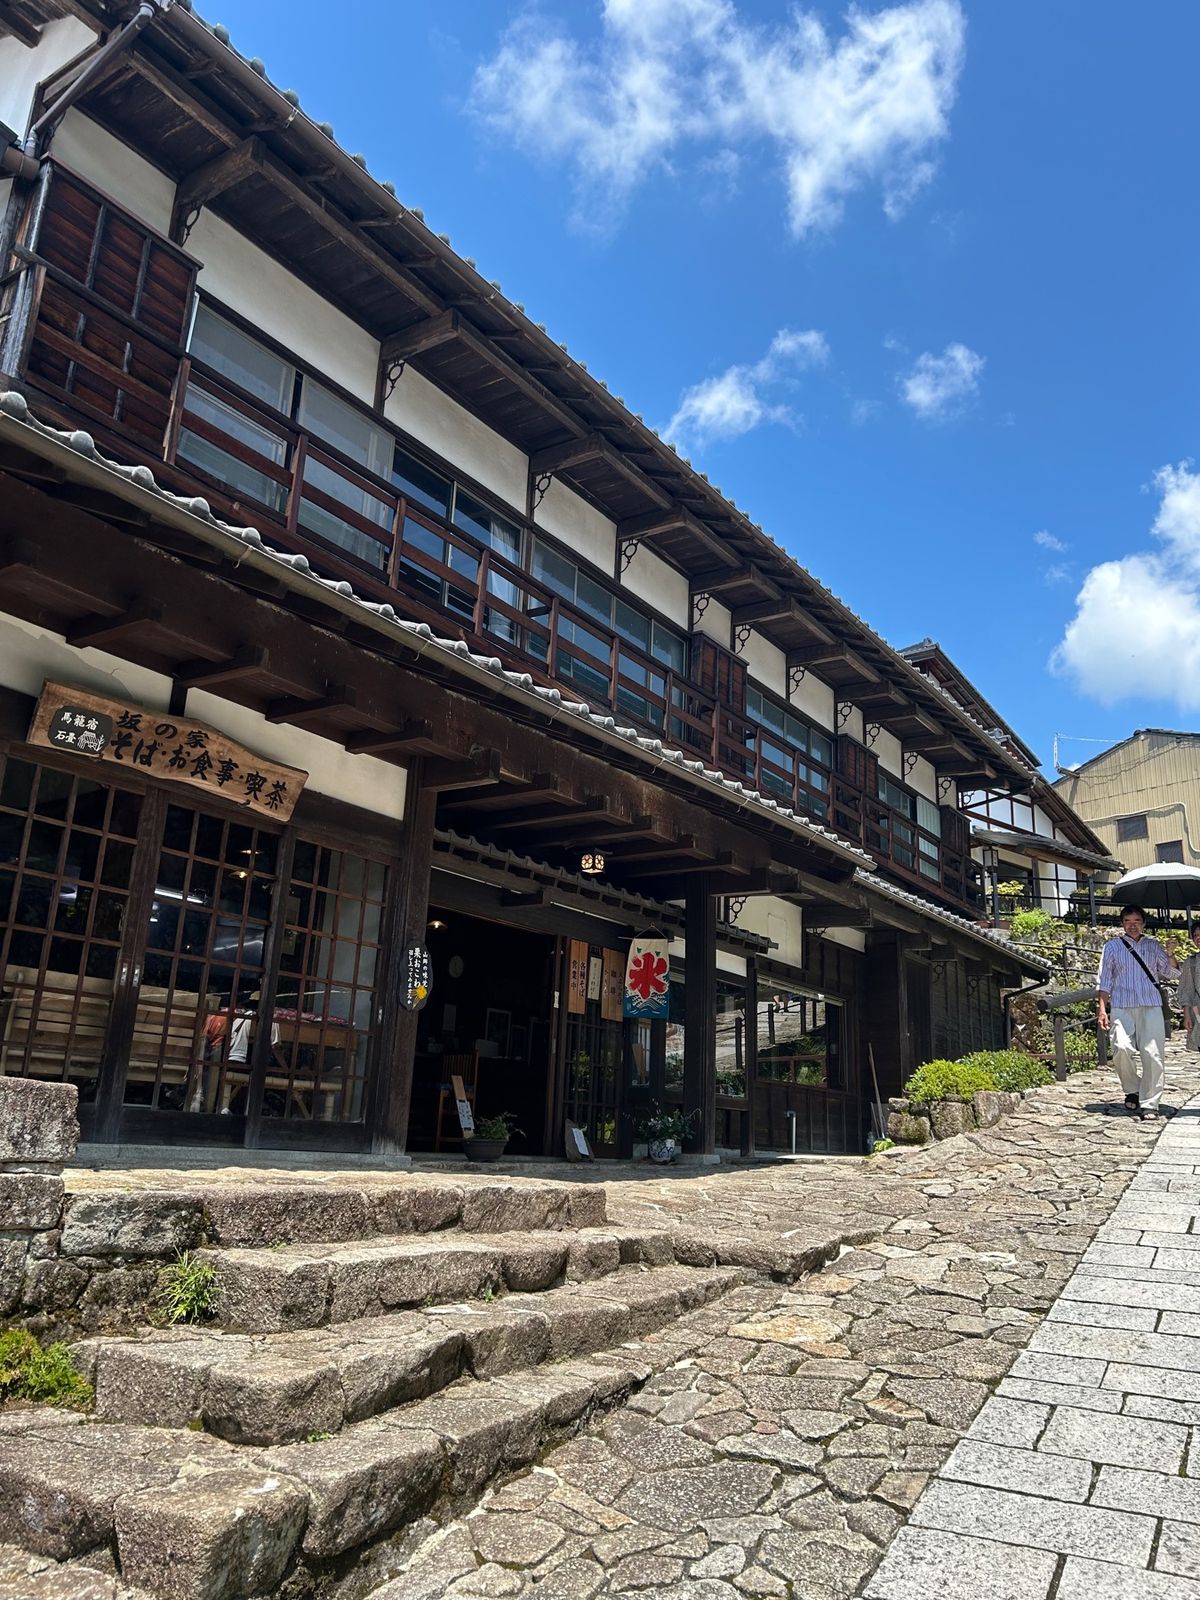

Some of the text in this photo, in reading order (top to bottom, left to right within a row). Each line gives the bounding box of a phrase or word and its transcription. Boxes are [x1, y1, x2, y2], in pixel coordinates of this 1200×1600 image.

[54, 730, 77, 744] 石畳
[60, 712, 99, 731] 馬籠宿
[116, 710, 209, 749] 坂の家
[110, 731, 288, 810] そば・お食事・喫茶
[628, 952, 667, 1000] 氷
